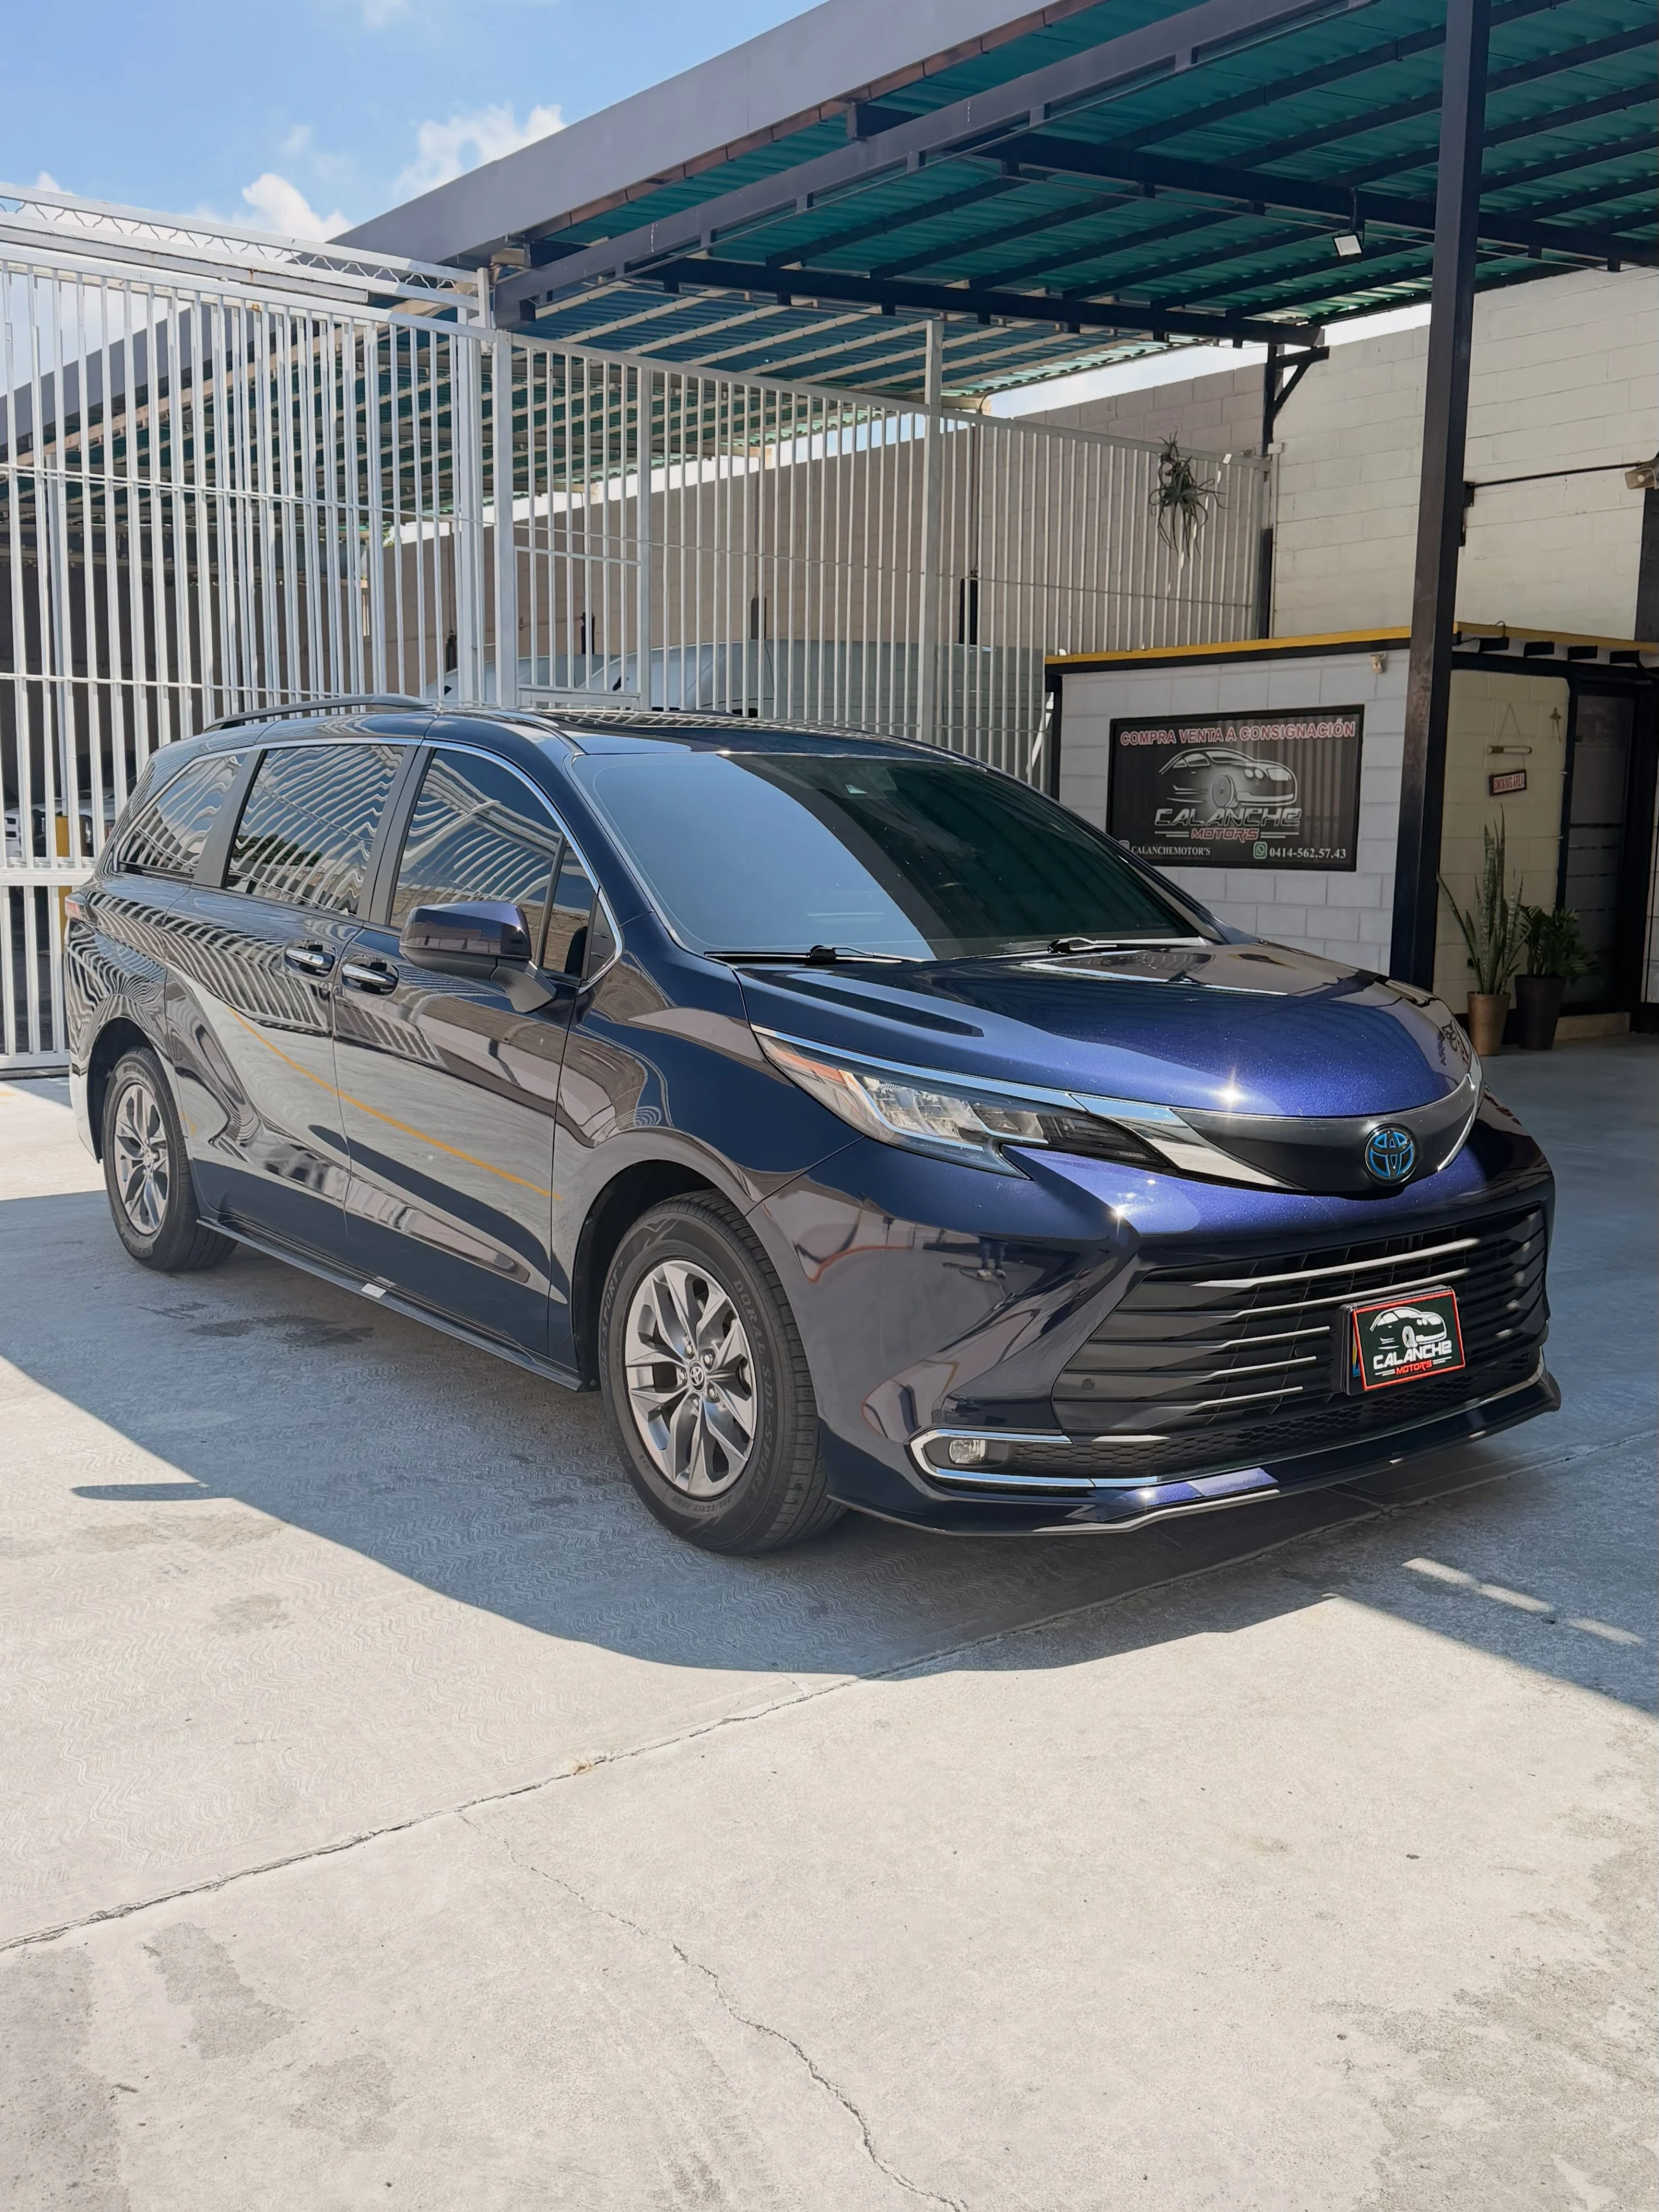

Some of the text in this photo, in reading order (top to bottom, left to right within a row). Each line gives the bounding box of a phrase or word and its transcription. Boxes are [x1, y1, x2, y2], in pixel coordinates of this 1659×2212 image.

[1120, 718, 1355, 746] COMPRA VENTA A CONSIGNACIÓN
[1155, 808, 1302, 827] CALANCHE
[1191, 828, 1259, 843] MOTOR'S
[1131, 846, 1211, 856] CALANCHEMOTOR'S
[1269, 847, 1346, 859] 0414-562.57.43
[1373, 1340, 1452, 1370] CALANCHE
